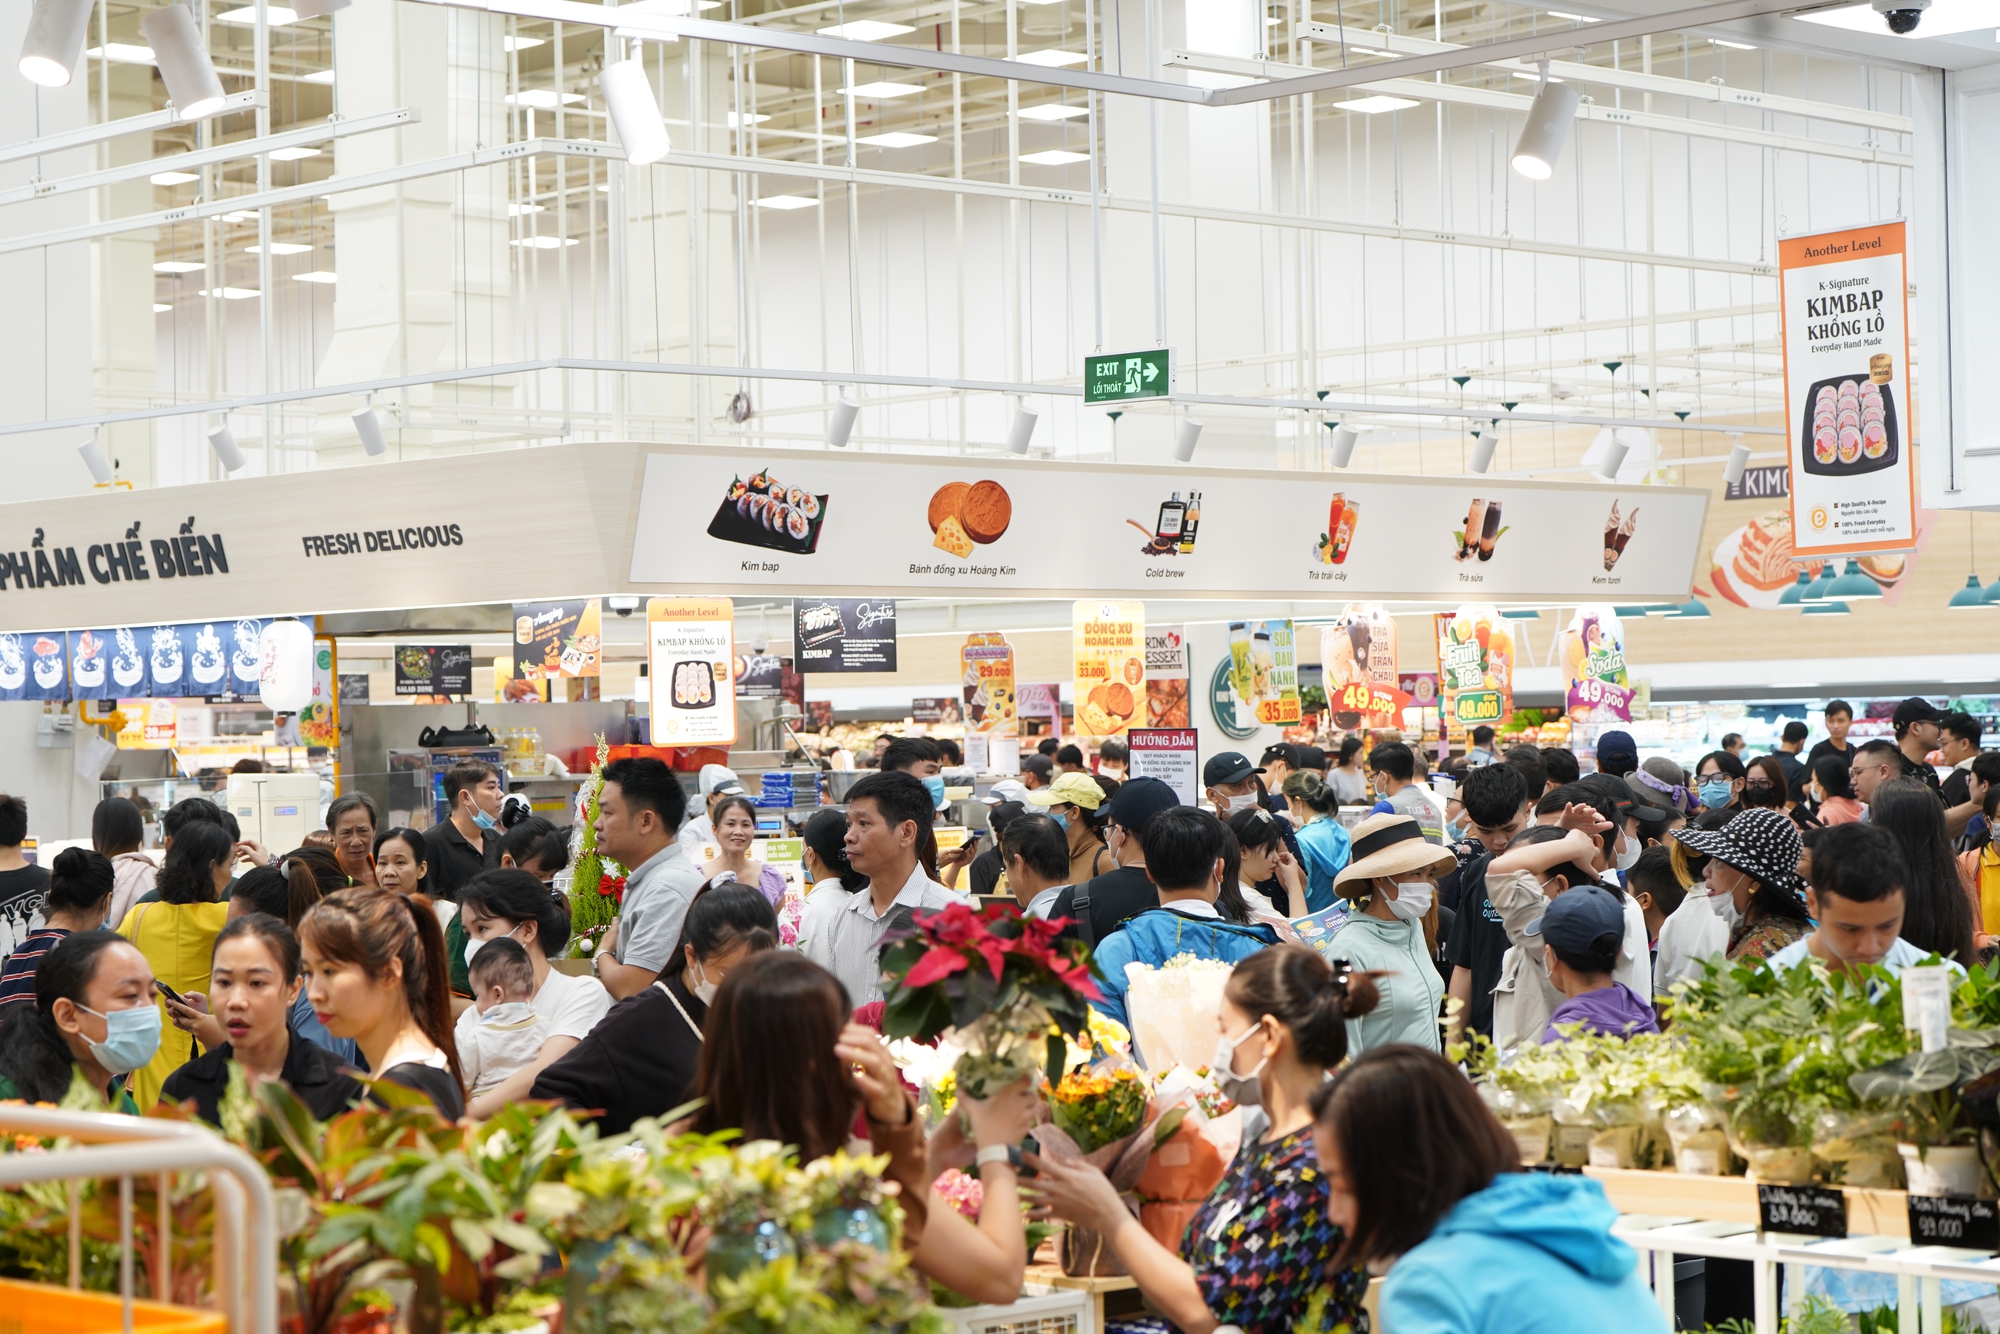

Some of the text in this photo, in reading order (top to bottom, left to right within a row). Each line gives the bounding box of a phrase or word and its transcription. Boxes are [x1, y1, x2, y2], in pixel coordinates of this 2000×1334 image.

[1804, 236, 1882, 258] Another Level
[1818, 277, 1870, 291] K-Signature
[1806, 289, 1884, 318] KIMBAP
[1807, 308, 1885, 341] KHỔNG LỒ
[1811, 337, 1882, 353] Everyday Hand Made
[1096, 362, 1119, 377] EXIT
[1093, 381, 1122, 394] LỐI THOÁT
[302, 523, 464, 557] FRESH DELICIOUS
[87, 521, 150, 584] CHẾ
[150, 516, 229, 579] BIẾN
[741, 561, 780, 573] Kim bap
[909, 563, 931, 574] Bánh
[970, 565, 998, 577] Hoàng
[999, 565, 1016, 575] Kim
[1145, 568, 1185, 578] Cold brew
[1308, 570, 1348, 582] Trà trái cây
[1459, 573, 1484, 582] Trà sữa
[1591, 575, 1607, 584] Kem
[663, 607, 719, 616] Another Level
[1084, 616, 1133, 635] ĐỒNG XU
[657, 638, 687, 646] KIMBAP
[689, 634, 715, 646] KHỔNG
[1085, 634, 1134, 646] HOÀNG KIM
[1145, 636, 1168, 649] RINK
[802, 649, 833, 659] KIMBAP
[1145, 650, 1182, 663] ESSERT
[1446, 641, 1479, 667] Fruit
[1586, 649, 1623, 677] Soda
[980, 666, 1011, 677] 29.000
[1079, 667, 1106, 678] 33.000
[1457, 666, 1482, 688] Tea
[396, 685, 434, 693] SALAD ZONE
[1578, 680, 1624, 709] 49.000
[1343, 685, 1396, 714] 49.000
[1264, 701, 1298, 721] 35.000
[1459, 699, 1498, 719] 49.000
[1132, 731, 1194, 746] HƯỚNG DẪN
